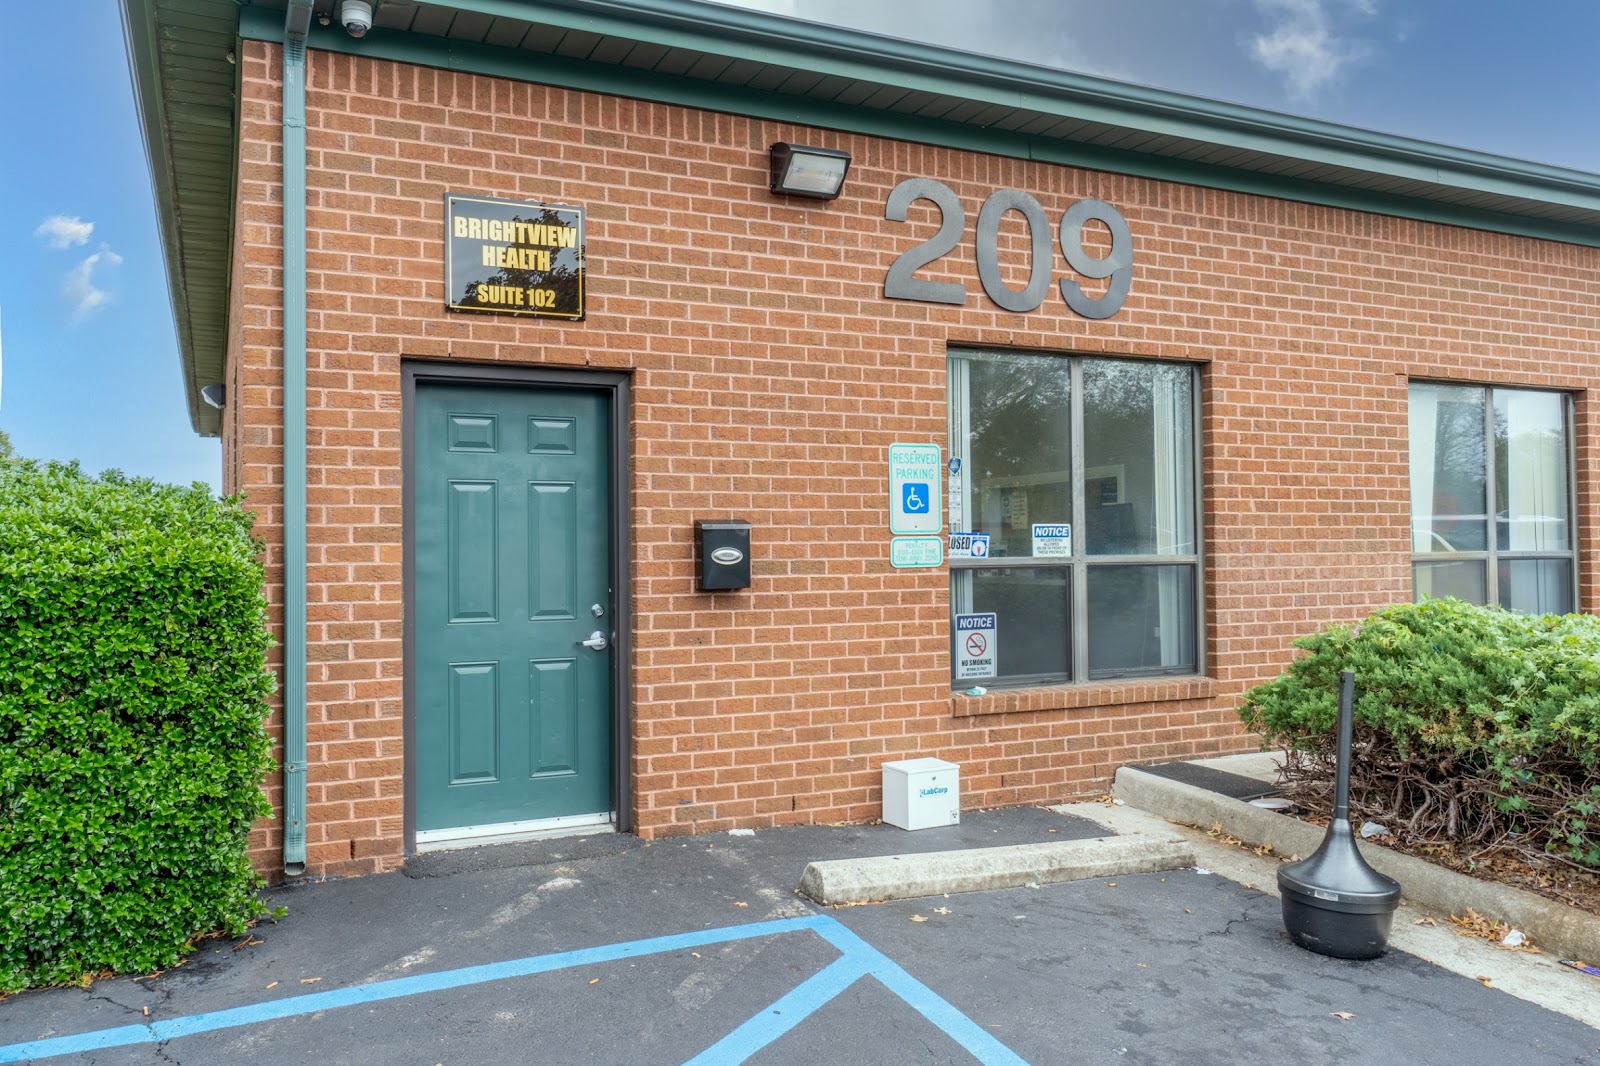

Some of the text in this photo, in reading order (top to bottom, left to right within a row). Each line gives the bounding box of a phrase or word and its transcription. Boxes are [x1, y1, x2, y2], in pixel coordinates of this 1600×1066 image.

[454, 216, 577, 248] BRIGHTVIEW
[885, 177, 1133, 320] 209
[482, 245, 551, 272] HEALTH
[477, 284, 556, 308] SUITE 102
[893, 453, 937, 465] RESERVED
[896, 468, 935, 480] PARKING
[1035, 527, 1069, 537] NOTICE
[960, 617, 992, 629] NOTICE
[969, 658, 992, 667] SMOKING
[923, 787, 948, 795] LabCorp
